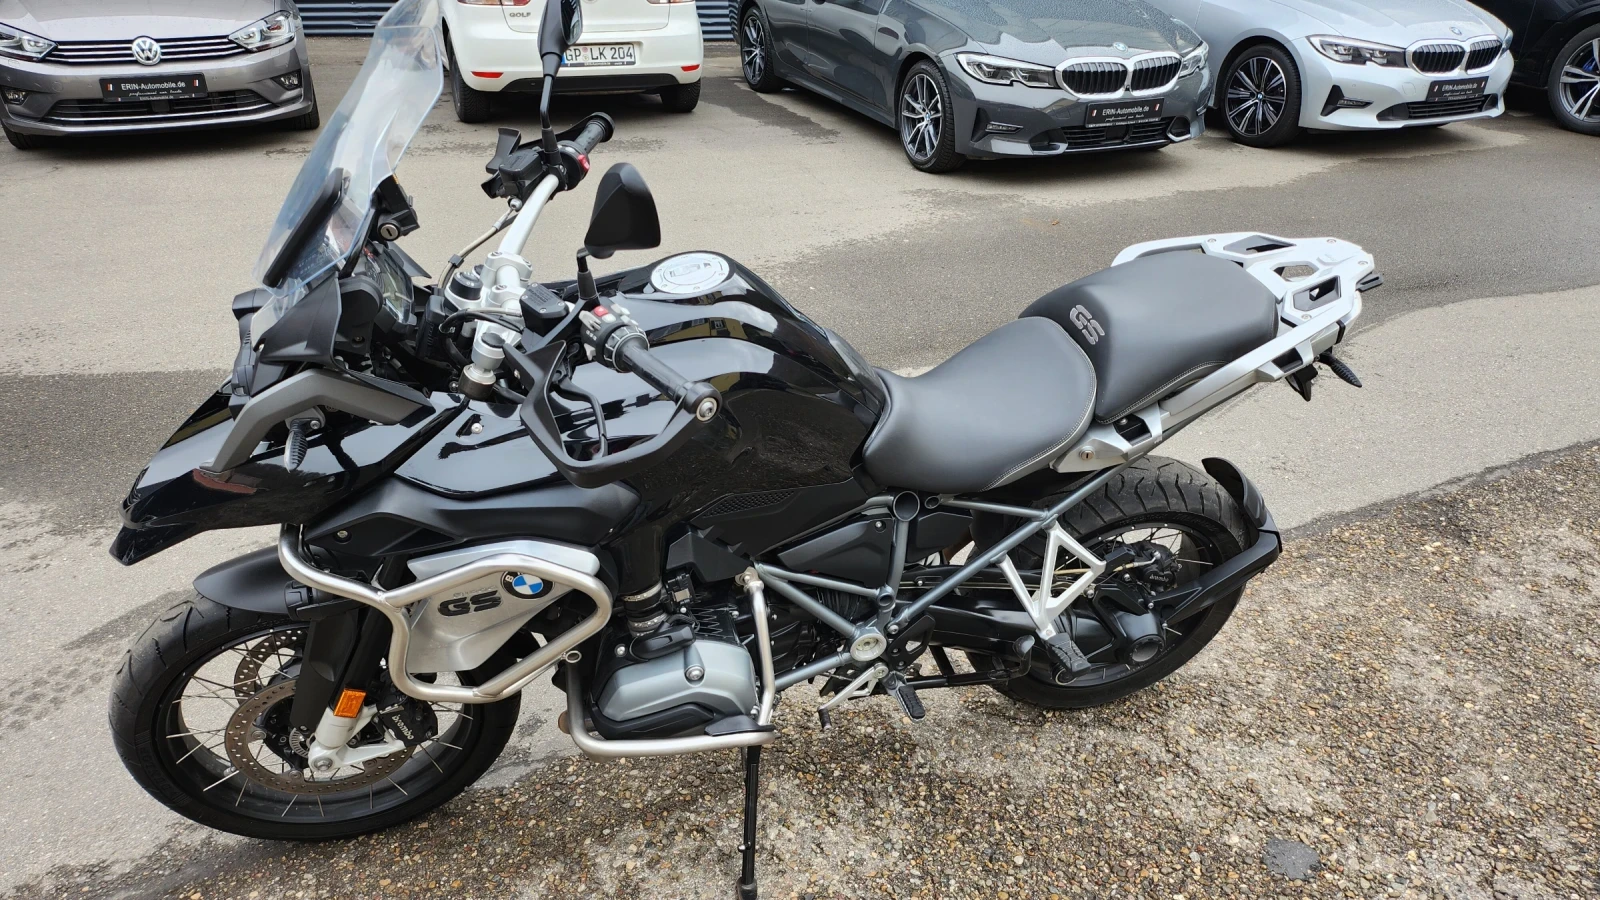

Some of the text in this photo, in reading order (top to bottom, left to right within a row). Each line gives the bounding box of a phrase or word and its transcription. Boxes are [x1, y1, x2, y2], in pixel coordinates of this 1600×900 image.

[565, 46, 633, 61] GP LK 204
[121, 81, 186, 91] ERIN-Automobile.de
[1102, 105, 1149, 116] ERIN-Automobile.de
[1070, 304, 1105, 345] GS
[437, 590, 502, 617] GS
[391, 714, 415, 740] brembo
